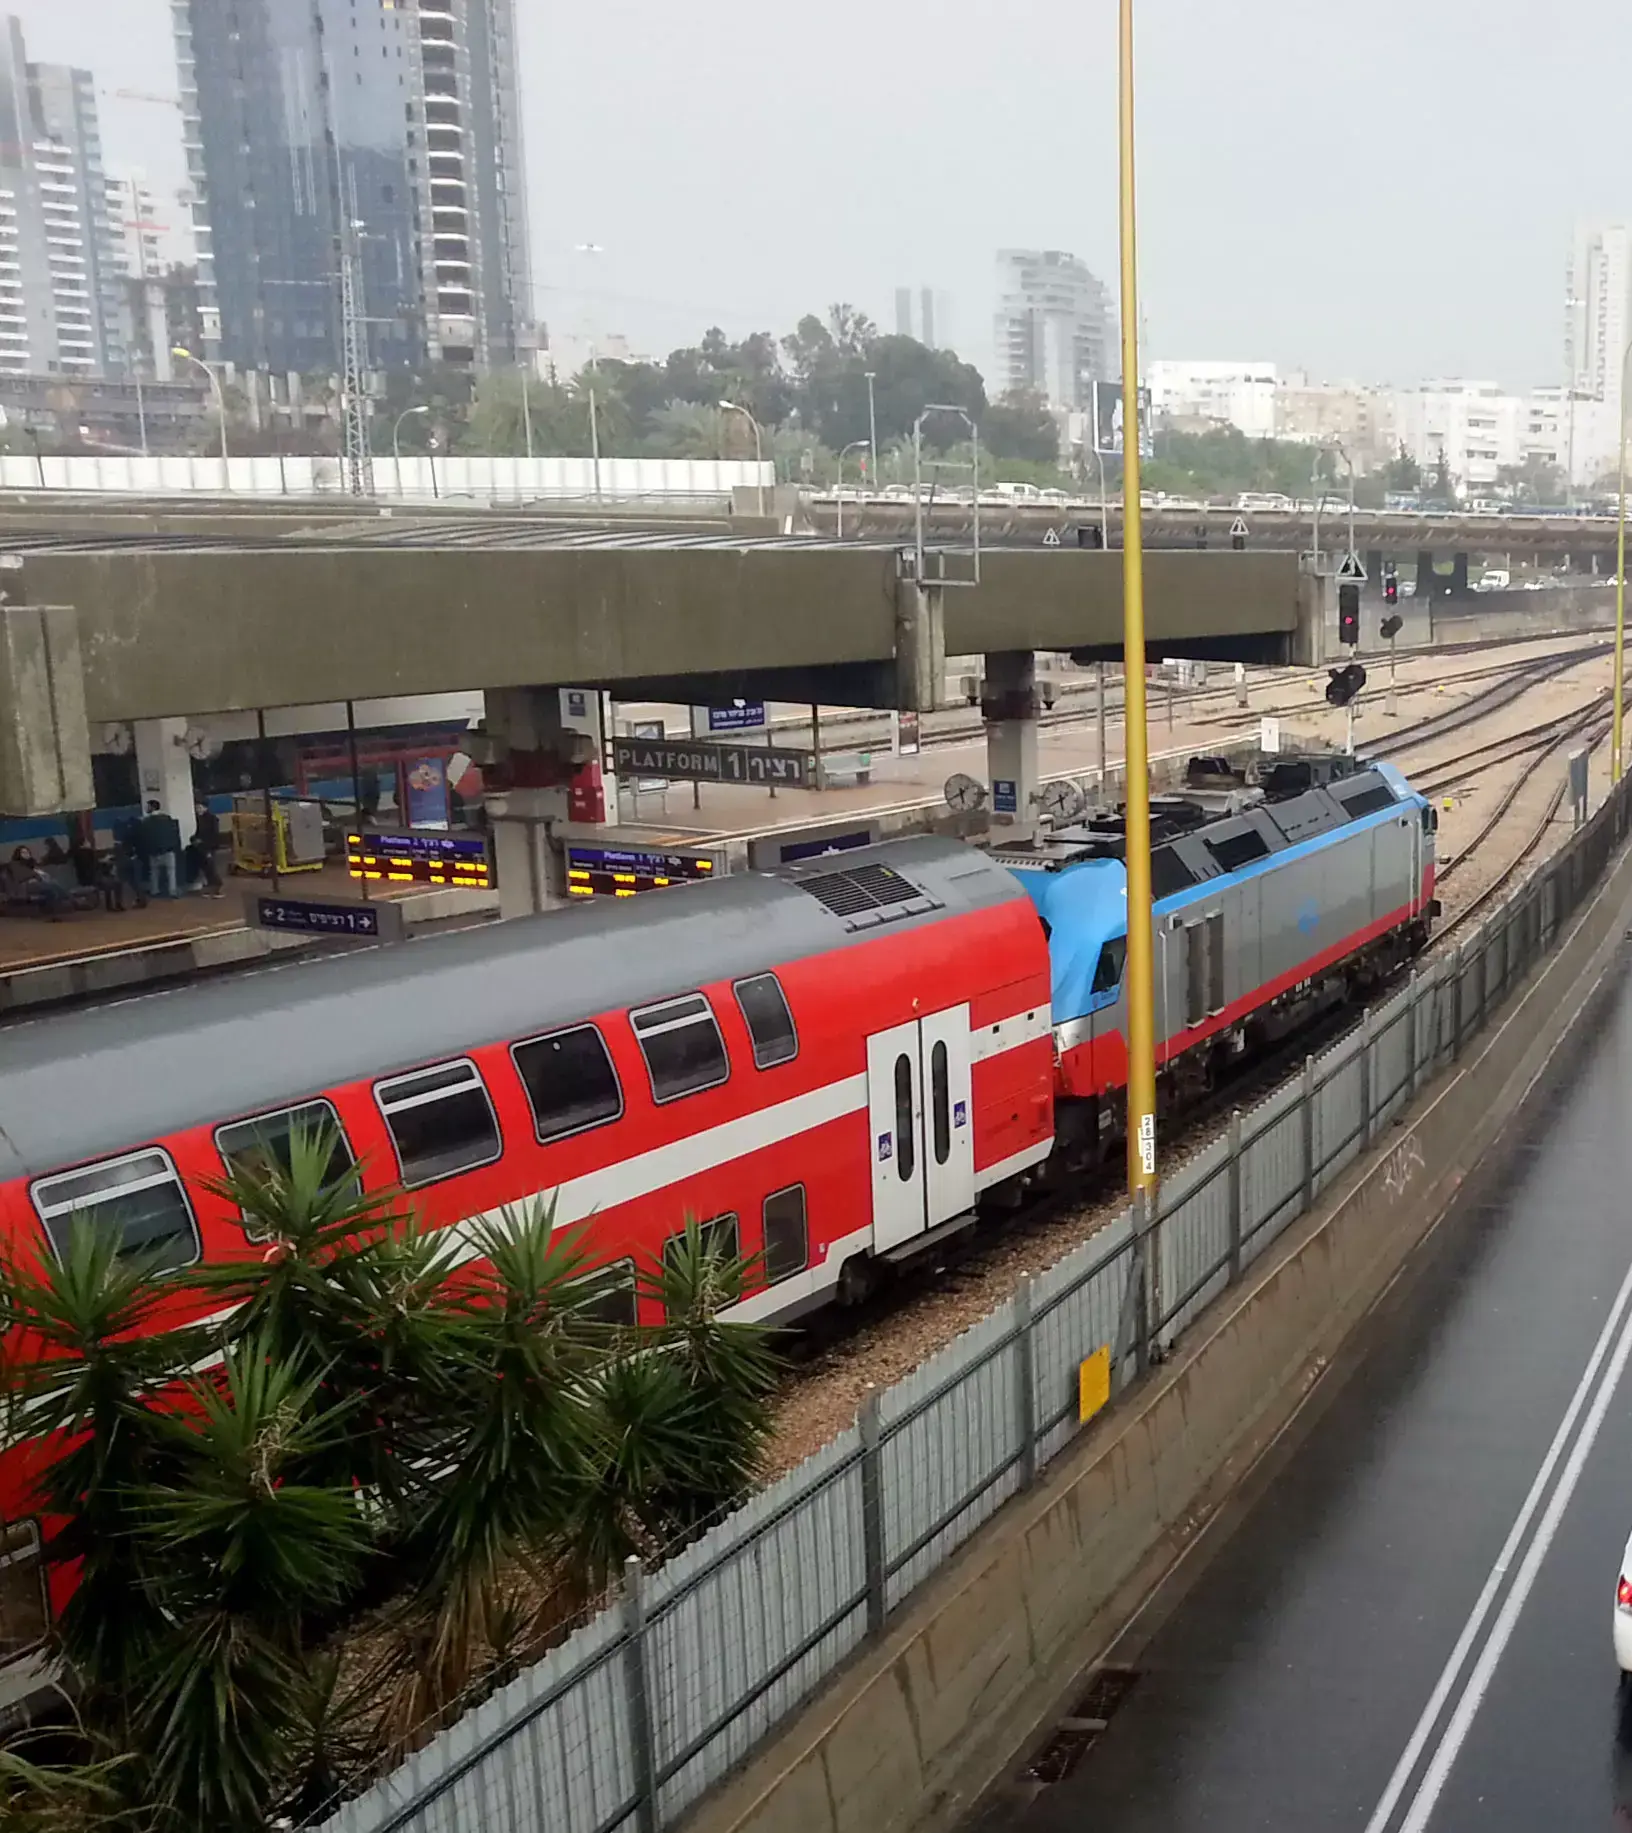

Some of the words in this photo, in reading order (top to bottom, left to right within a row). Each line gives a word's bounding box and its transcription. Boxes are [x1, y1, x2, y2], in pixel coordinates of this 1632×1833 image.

[619, 748, 718, 772] PLATFORM
[728, 752, 741, 778] 1
[751, 756, 800, 779] רציף
[277, 908, 285, 921] 2
[347, 914, 355, 928] 1
